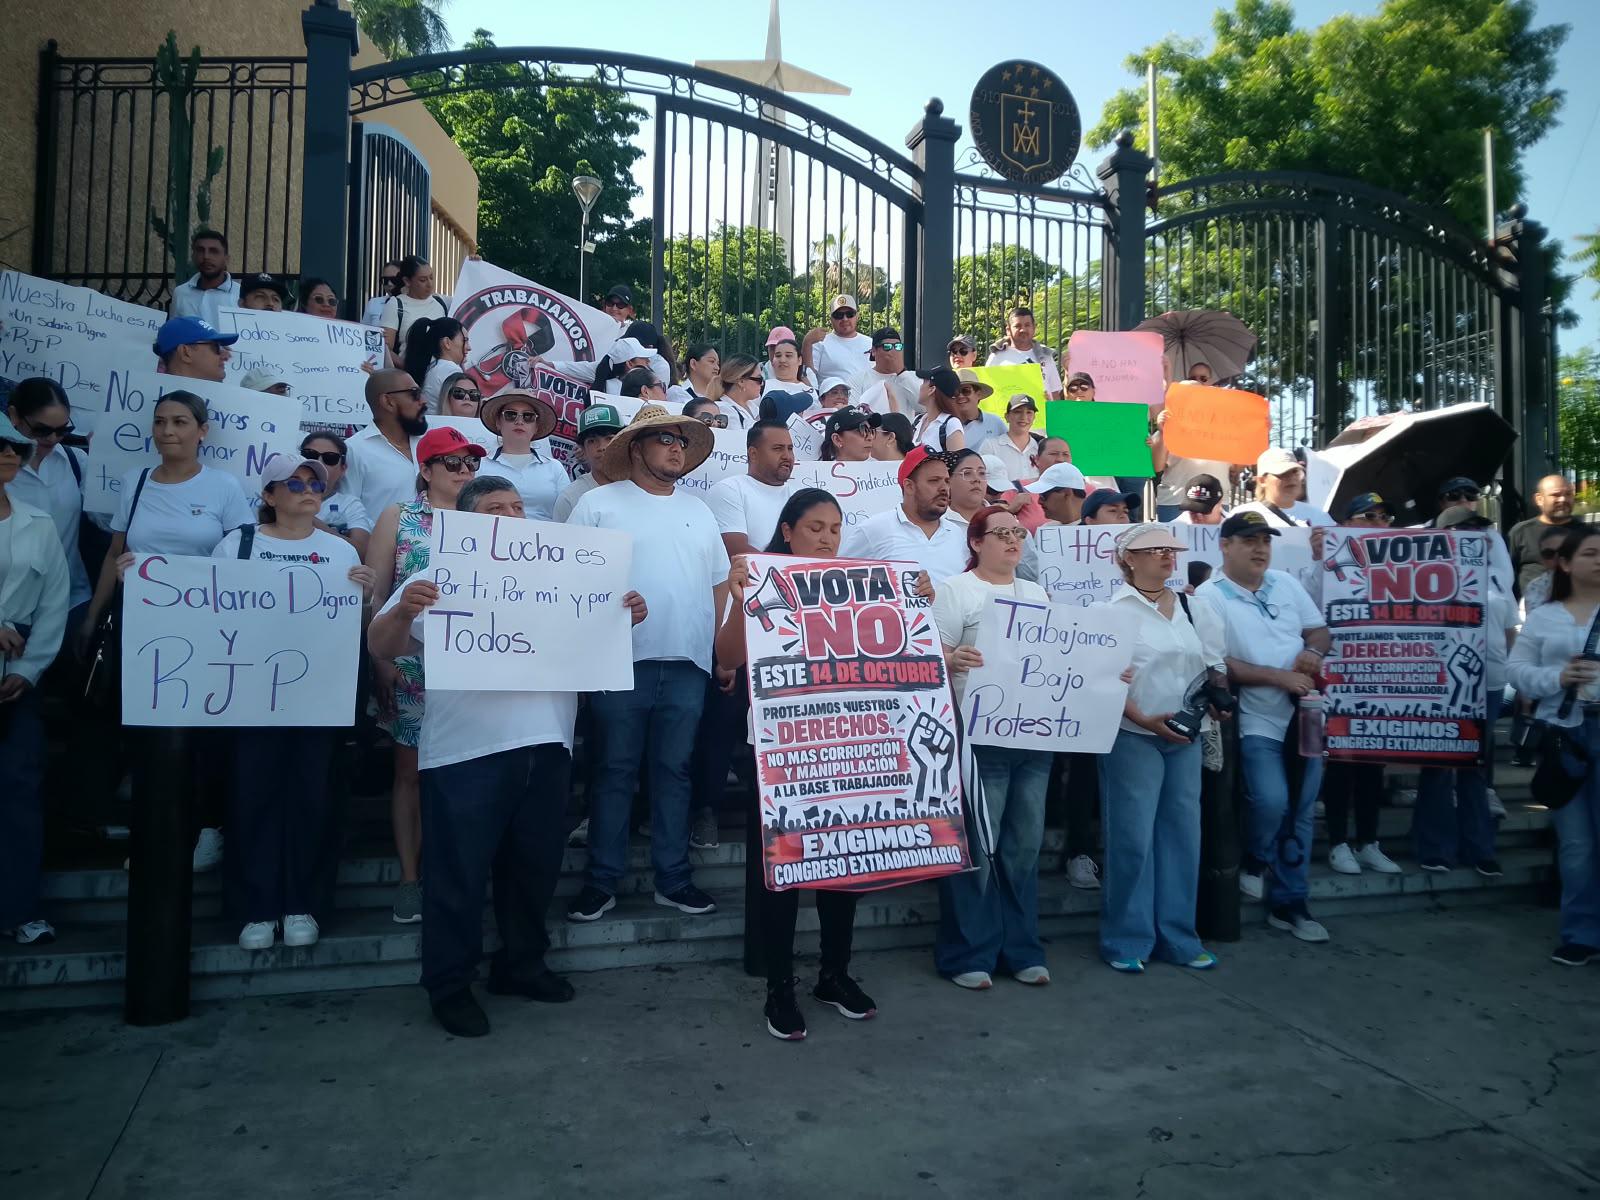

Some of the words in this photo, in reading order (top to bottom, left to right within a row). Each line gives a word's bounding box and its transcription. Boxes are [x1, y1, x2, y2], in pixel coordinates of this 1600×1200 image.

[2, 272, 75, 312] Nuestra
[86, 293, 123, 323] Lucha
[127, 316, 145, 327] es
[37, 316, 73, 332] Salario
[76, 321, 107, 341] Digno
[219, 311, 280, 341] Todos
[326, 323, 363, 347] IMSS
[479, 289, 588, 351] TRABAJAMOS
[2, 350, 16, 374] Y
[17, 361, 37, 376] por
[104, 370, 145, 412] No
[260, 421, 277, 434] a
[539, 371, 589, 401] VOTA
[439, 511, 477, 555] La
[490, 516, 565, 562] Lucha
[575, 548, 606, 566] es
[1364, 533, 1452, 565] VOTA
[1460, 559, 1484, 567] IMSS
[138, 555, 276, 614] Salario
[279, 565, 359, 620] Digno
[434, 567, 462, 596] Por
[501, 575, 526, 602] Por
[536, 586, 558, 604] mi
[588, 591, 613, 613] por
[791, 566, 897, 607] VOTA
[1040, 565, 1104, 594] Presente
[1370, 561, 1458, 603] NO
[994, 598, 1118, 655] Trabajamos
[1331, 603, 1370, 621] ESTE
[1394, 605, 1414, 621] DE
[219, 629, 238, 656] Y
[428, 609, 536, 654] Todos.
[803, 604, 904, 658] NO
[759, 662, 808, 689] ESTE
[810, 662, 833, 684] 14
[835, 661, 861, 683] DE
[863, 661, 940, 684] OCTUBRE
[1020, 654, 1084, 702] Bajo
[1329, 663, 1345, 673] NO
[1346, 663, 1372, 673] MAS
[1343, 673, 1352, 682] Y
[1332, 685, 1338, 694] A
[1340, 685, 1352, 694] LA
[1354, 685, 1379, 694] BASE
[1381, 685, 1449, 695] TRABAJADORA
[762, 702, 841, 720] PROTEJAMOS
[967, 683, 1080, 738] Protesta
[777, 712, 896, 745] DERECHOS,
[1327, 736, 1384, 750] CONGRESO
[1350, 718, 1460, 738] EXIGIMOS
[766, 752, 785, 768] NO
[787, 750, 818, 766] MAS
[819, 739, 901, 762] CORRUPCIÓN
[784, 767, 794, 781] Y
[796, 756, 898, 780] MANIPULACIÓN
[773, 785, 782, 799] A
[783, 784, 797, 798] LA
[799, 781, 830, 796] BASE
[832, 772, 914, 793] TRABAJADORA
[801, 822, 933, 860] EXIGIMOS
[773, 857, 847, 886] CONGRESO
[849, 844, 962, 876] EXTRAORDINARIO
